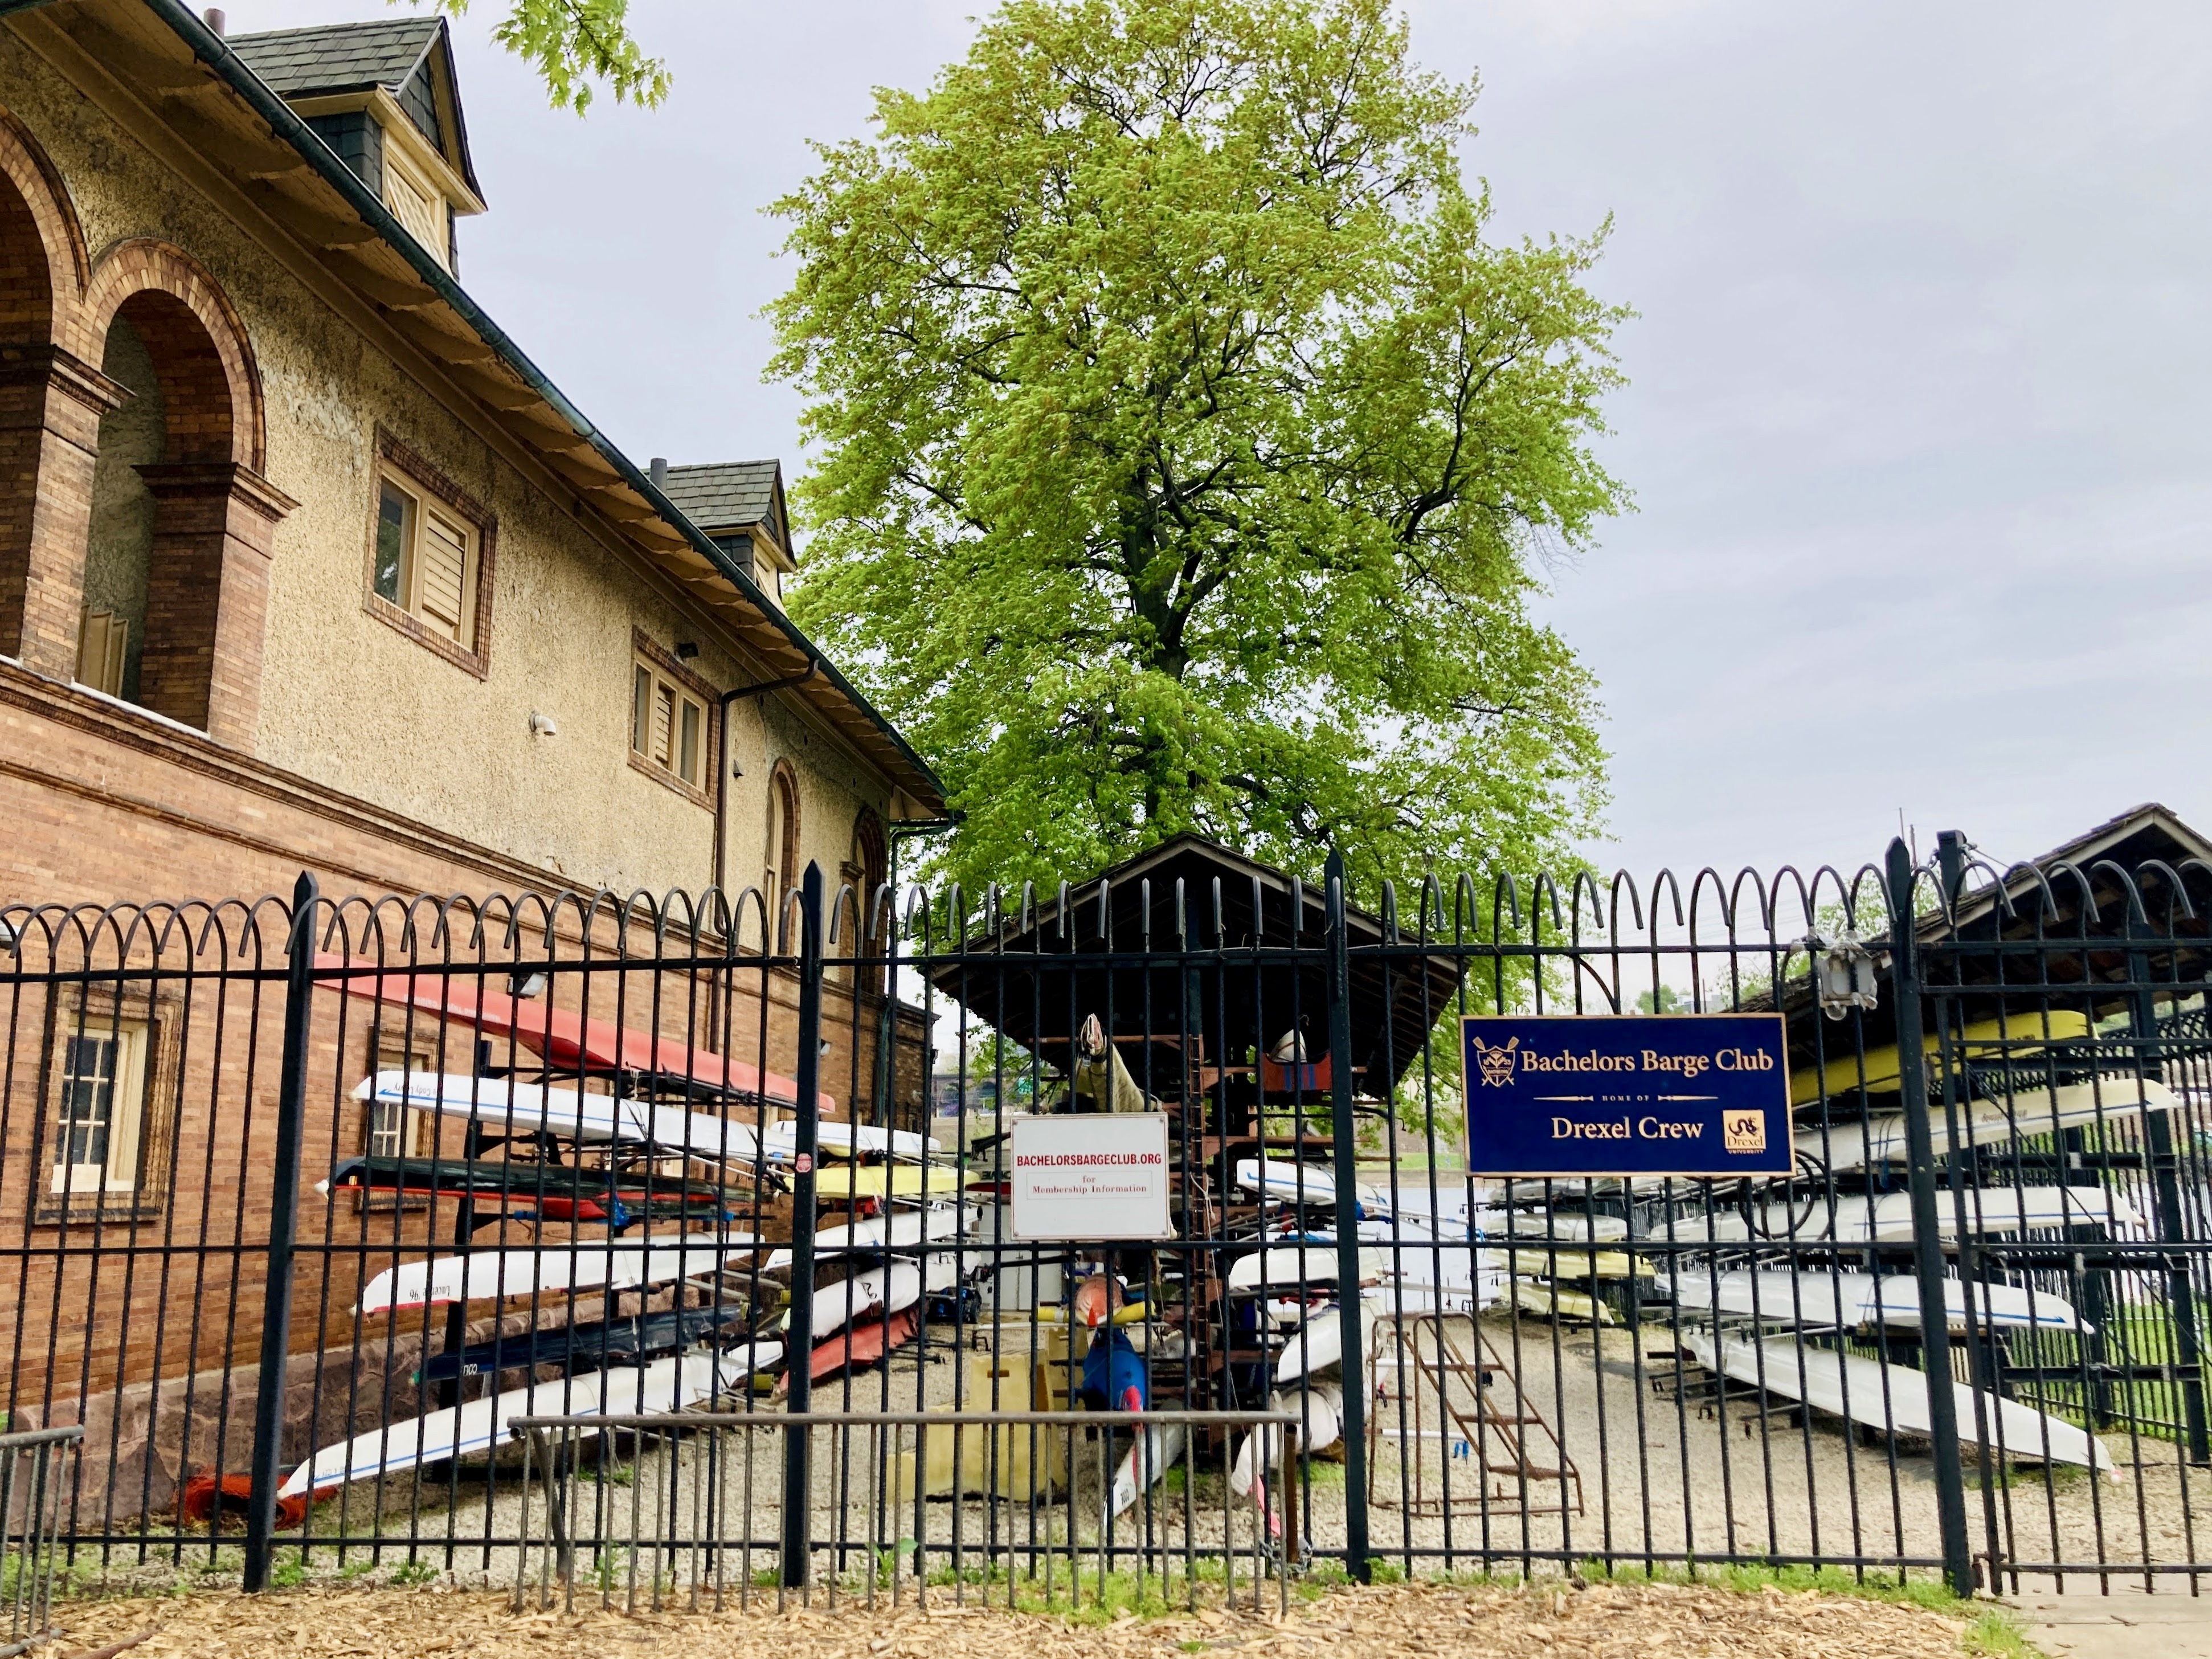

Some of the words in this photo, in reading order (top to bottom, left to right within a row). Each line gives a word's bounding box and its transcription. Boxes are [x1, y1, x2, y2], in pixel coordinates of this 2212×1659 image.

[1520, 1049, 1636, 1072] Bachelors
[1641, 1050, 1710, 1078] Barge
[1715, 1048, 1773, 1071] Club
[1551, 1117, 1630, 1139] Drexel
[1638, 1117, 1704, 1139] Crew
[1727, 1135, 1763, 1146] Drexel
[1017, 1153, 1162, 1167] BACHELORSBARGECLUB.ORG
[1082, 1175, 1096, 1183] for
[1032, 1185, 1087, 1195] Membership
[1091, 1184, 1147, 1193] Information
